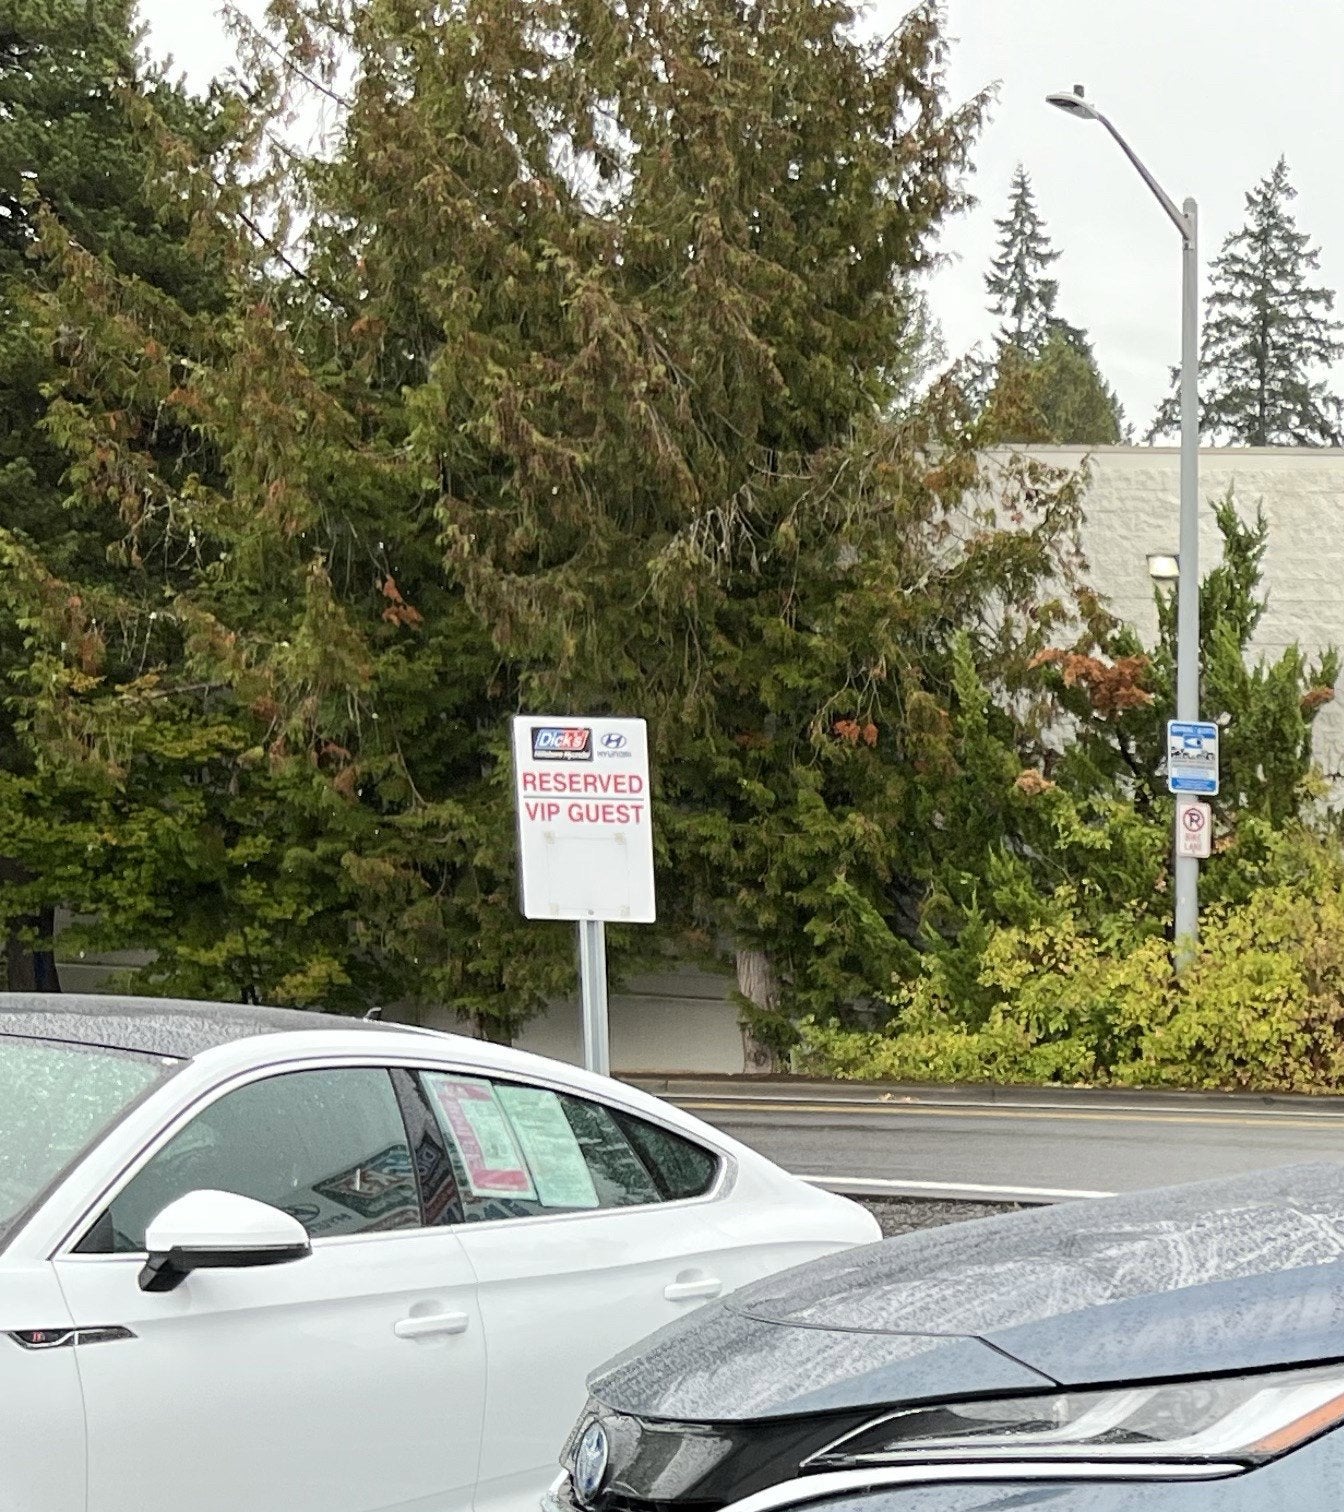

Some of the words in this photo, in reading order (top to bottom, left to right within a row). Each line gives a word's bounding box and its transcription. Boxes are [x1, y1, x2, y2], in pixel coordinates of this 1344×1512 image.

[522, 772, 643, 794] RESERVED
[524, 802, 560, 821] VIP
[568, 803, 644, 824] GUEST
